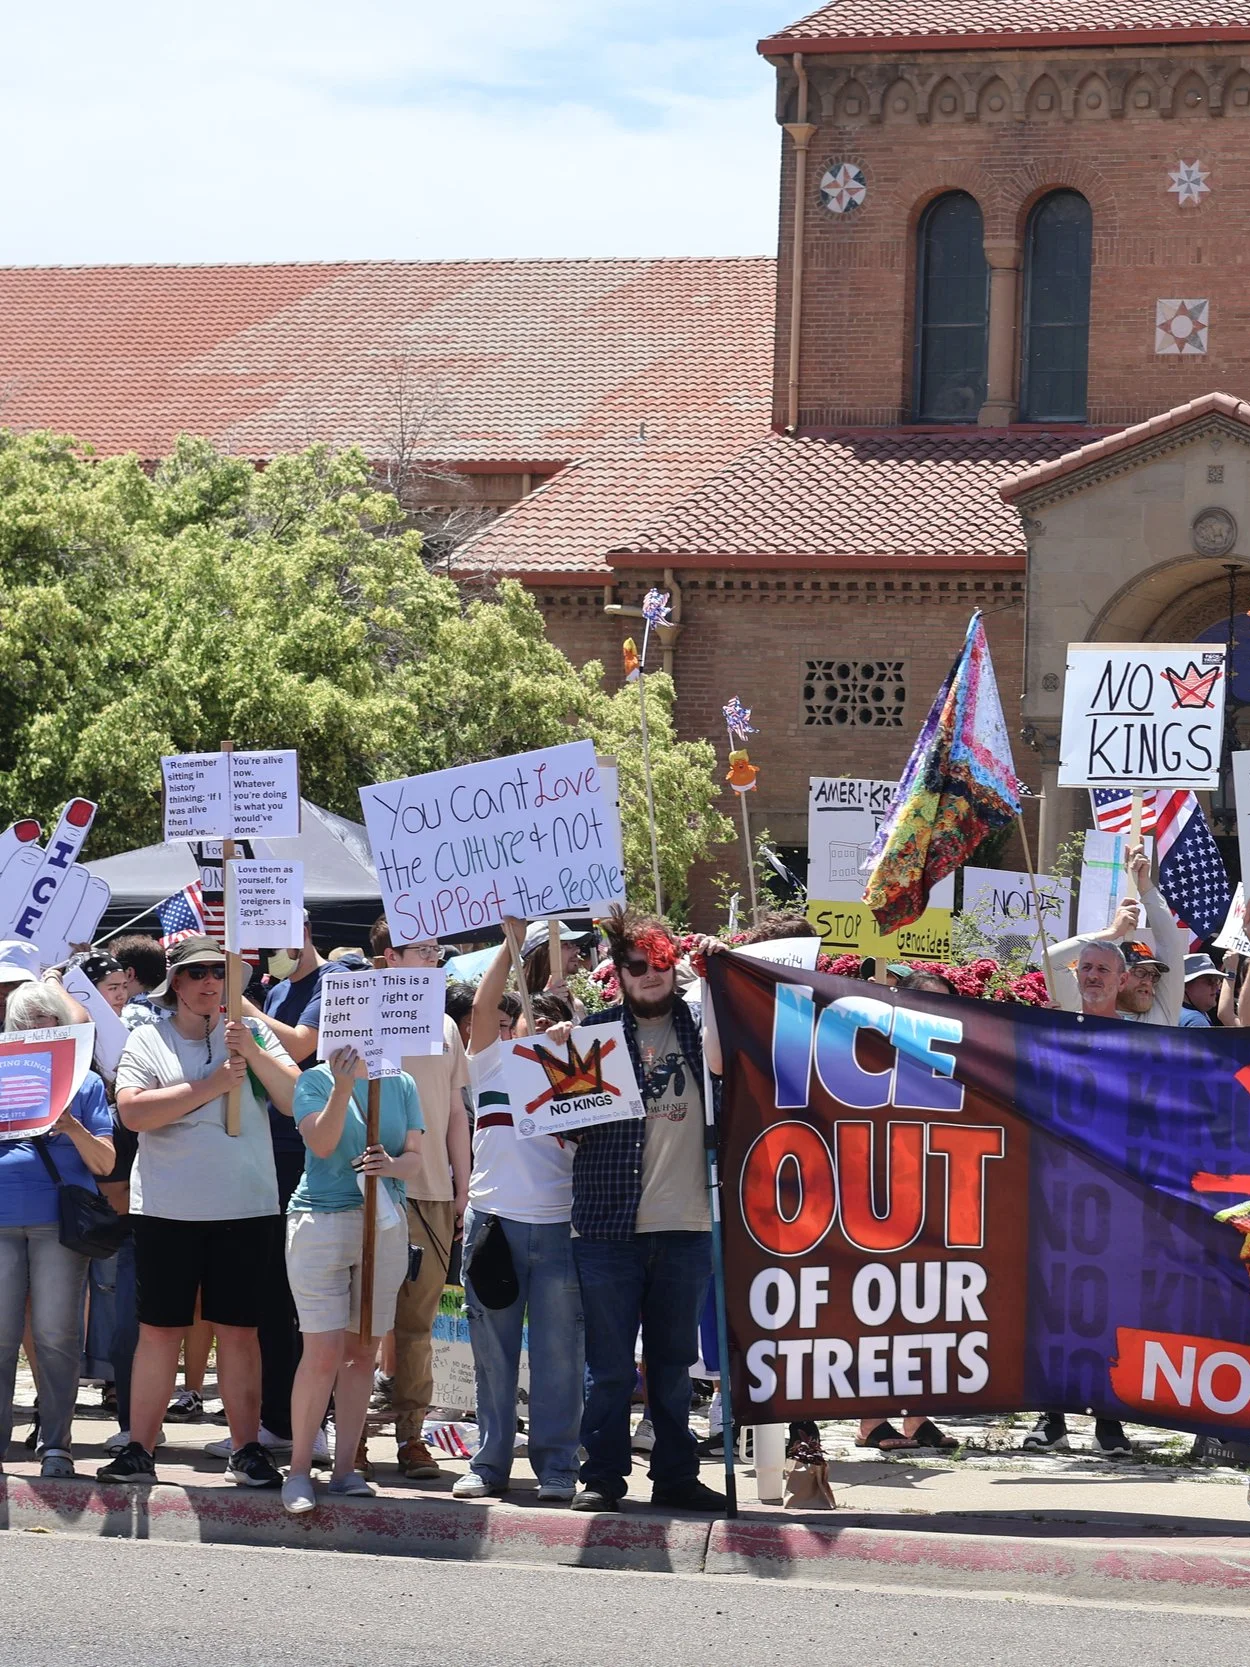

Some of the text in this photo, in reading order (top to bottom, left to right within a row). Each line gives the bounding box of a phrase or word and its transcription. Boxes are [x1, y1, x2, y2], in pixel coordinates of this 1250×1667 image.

[1091, 660, 1153, 711] NO
[1089, 719, 1212, 774] KINGS
[233, 757, 261, 765] You're
[168, 772, 194, 781] sitting
[169, 784, 195, 792] history
[233, 779, 275, 788] Whatever
[169, 794, 205, 804] thinking:
[233, 791, 287, 800] you're doing
[815, 781, 897, 810] AMERI-KR
[234, 802, 283, 811] is what you
[373, 787, 441, 840] You
[533, 763, 600, 808] Love
[169, 805, 207, 815] was alive
[168, 818, 188, 826] then
[234, 814, 273, 822] would've
[380, 849, 426, 893] the
[552, 808, 603, 857] not
[238, 876, 287, 885] yourself, for
[15, 840, 74, 939] ICE
[240, 898, 281, 906] oreigners
[394, 863, 623, 940] SUPPort the PeoPle
[816, 911, 862, 938] STOP
[326, 978, 377, 990] This isn't
[382, 976, 429, 986] This is a
[335, 996, 355, 1006] left
[358, 996, 369, 1005] or
[382, 992, 424, 1004] right or
[324, 1013, 351, 1024] right
[381, 1009, 417, 1020] wrong
[323, 1028, 373, 1038] moment
[381, 1025, 430, 1035] moment
[365, 1048, 383, 1057] KINGS
[772, 983, 965, 1112] ICE
[550, 1094, 613, 1117] NO KINGS
[740, 1120, 1004, 1256] OUT
[749, 1261, 989, 1329] OF OUR
[746, 1331, 990, 1403] STREETS
[435, 1383, 463, 1394] UCK
